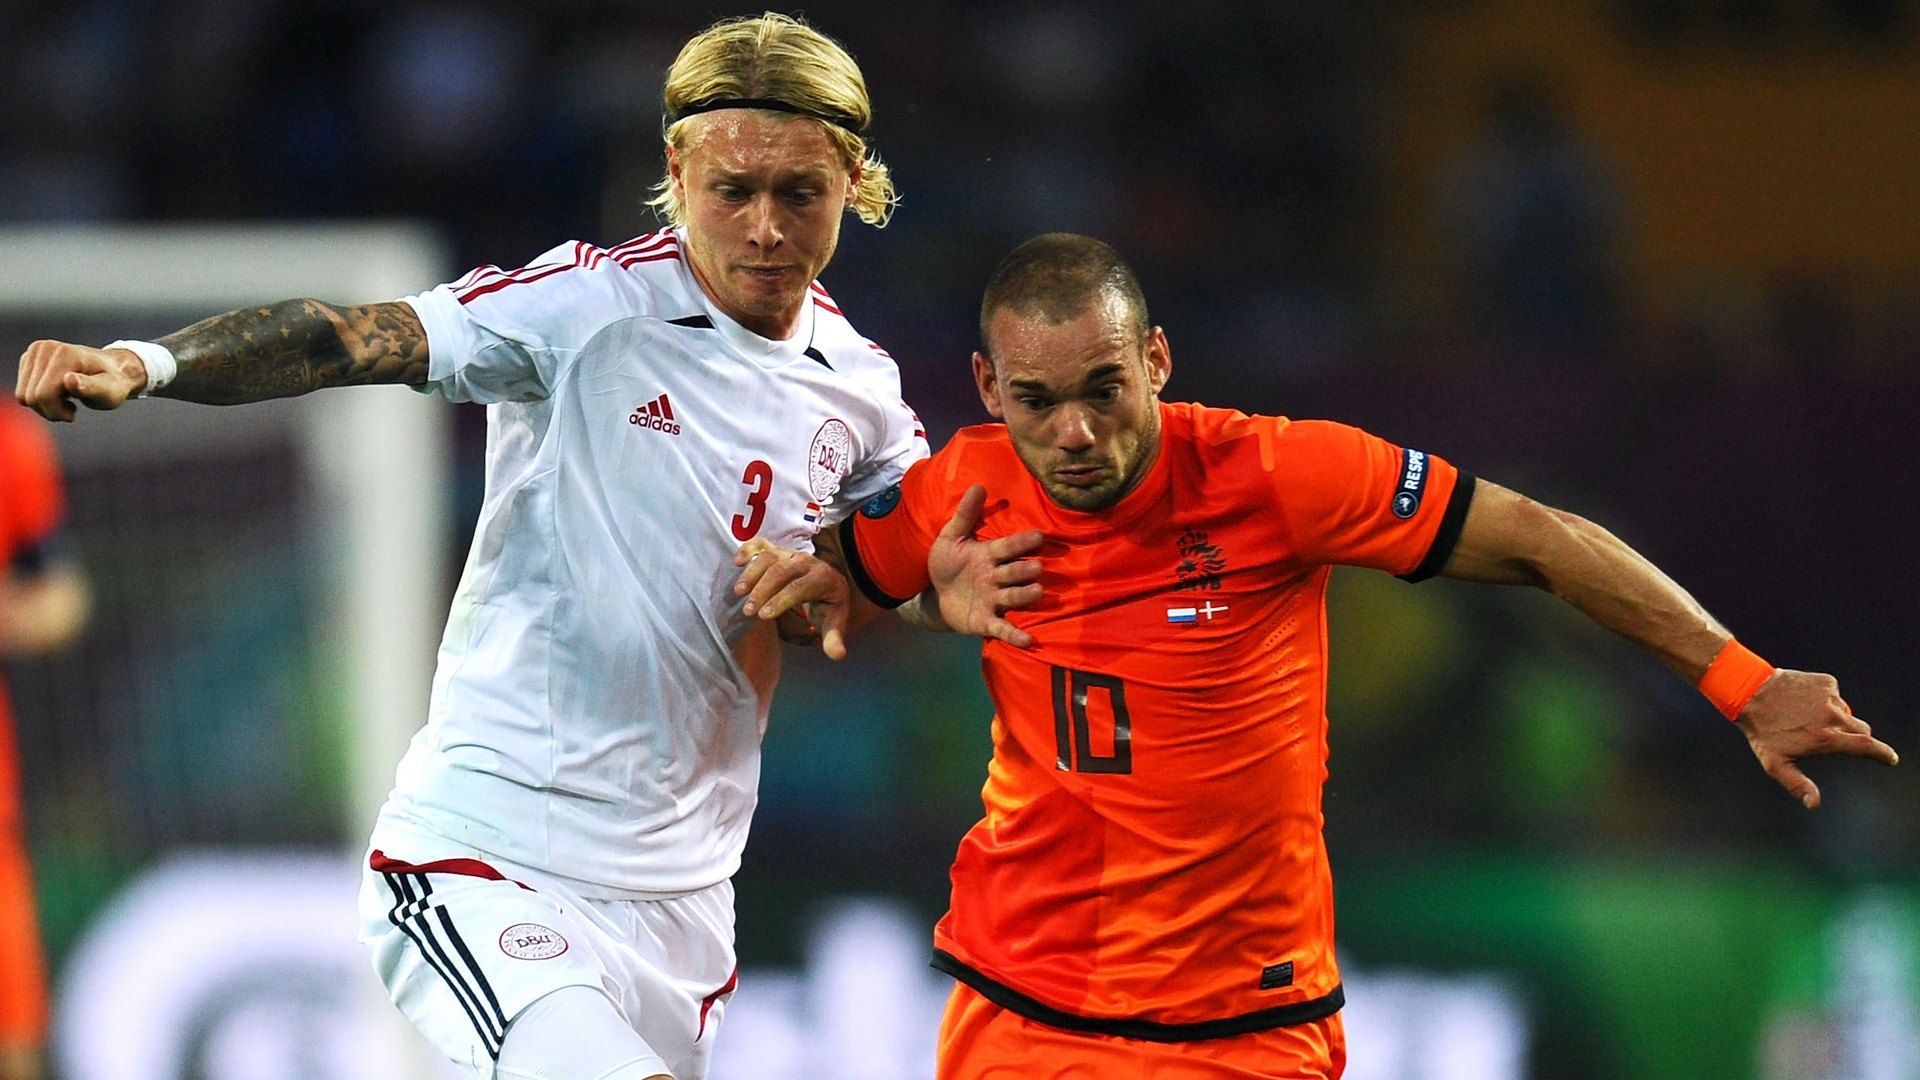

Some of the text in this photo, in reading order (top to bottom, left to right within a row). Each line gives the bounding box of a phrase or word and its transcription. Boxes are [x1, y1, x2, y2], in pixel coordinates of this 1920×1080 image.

[629, 413, 681, 435] adidas
[818, 445, 841, 474] DBU
[1404, 449, 1424, 490] RESPE
[731, 459, 773, 542] 3
[1050, 665, 1133, 775] 10
[515, 935, 552, 949] DBU
